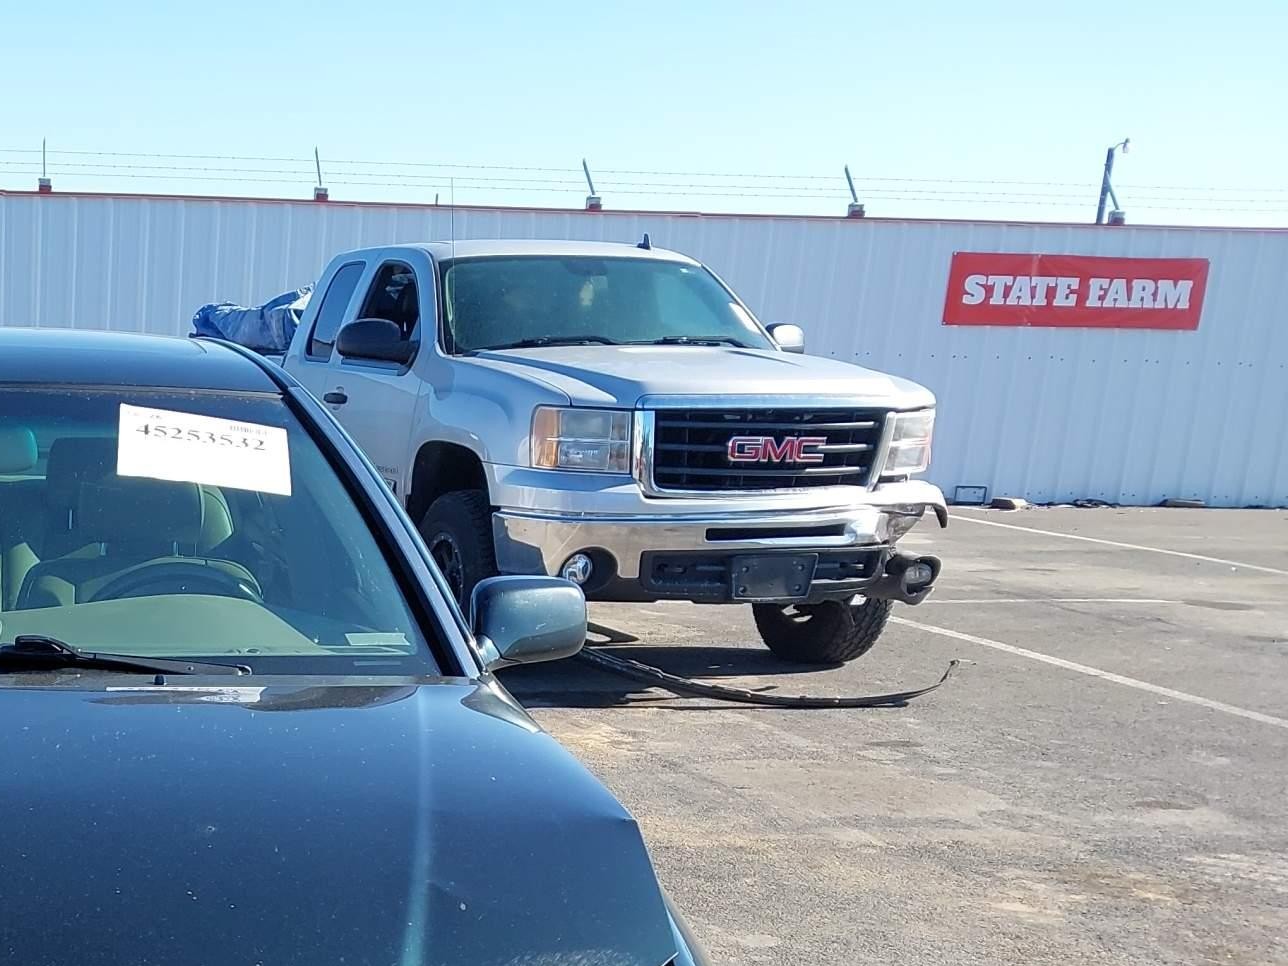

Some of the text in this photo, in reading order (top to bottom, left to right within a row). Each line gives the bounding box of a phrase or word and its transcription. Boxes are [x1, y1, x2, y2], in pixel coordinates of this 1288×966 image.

[962, 274, 1194, 309] STATE FARM
[136, 423, 267, 451] 45253532
[728, 436, 828, 462] GMC
